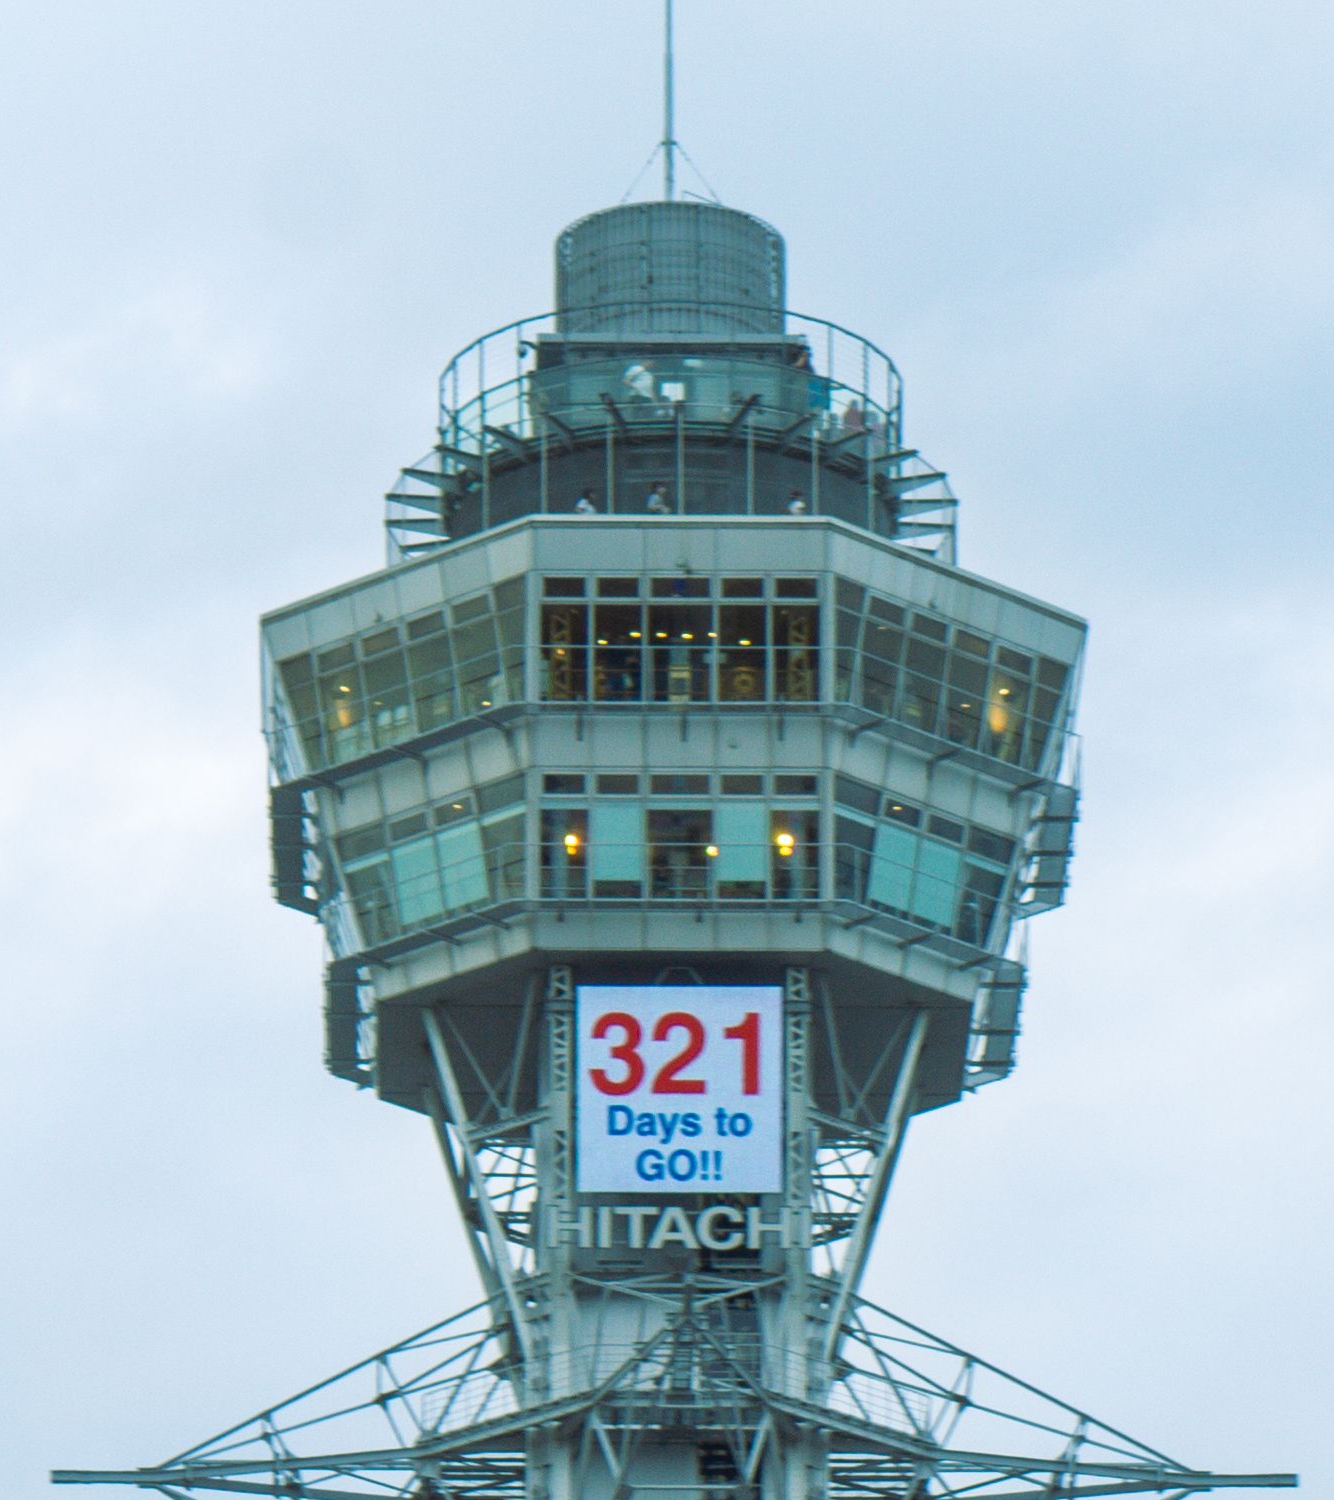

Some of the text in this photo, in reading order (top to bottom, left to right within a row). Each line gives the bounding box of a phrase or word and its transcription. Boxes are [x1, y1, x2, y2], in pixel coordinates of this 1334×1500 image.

[588, 1012, 760, 1096] 321
[607, 1104, 753, 1144] Days to
[635, 1149, 724, 1181] GO!!
[548, 1206, 810, 1250] HITACHI
